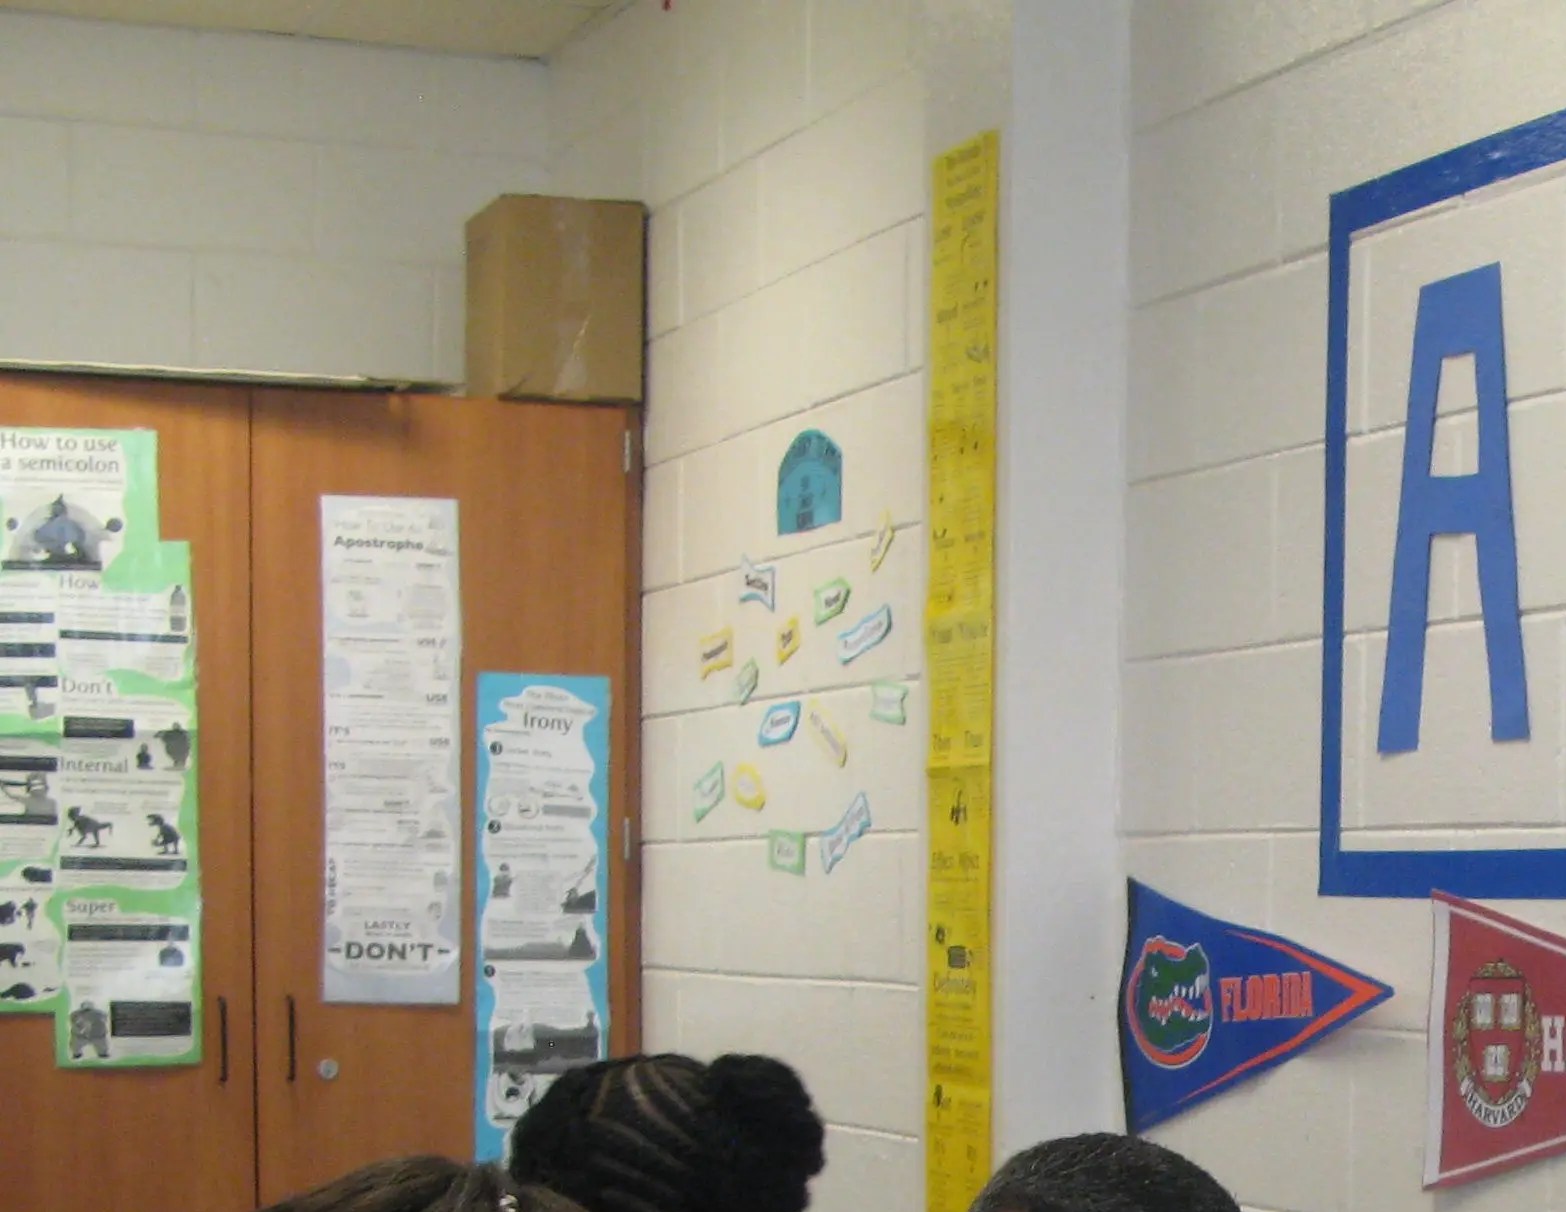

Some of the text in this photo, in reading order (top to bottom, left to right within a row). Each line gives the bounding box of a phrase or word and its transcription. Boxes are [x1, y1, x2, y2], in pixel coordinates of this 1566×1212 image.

[1, 432, 118, 453] How to use
[1, 456, 120, 473] a semicolon
[334, 535, 424, 552] Apostrophe
[59, 574, 100, 590] How
[61, 677, 114, 694] Don't
[524, 711, 574, 736] Irony
[60, 757, 129, 774] Internal
[68, 901, 117, 917] Super
[345, 941, 434, 962] DON'T
[1219, 970, 1314, 1023] FLORIDA
[1466, 1091, 1526, 1126] HARVARD
